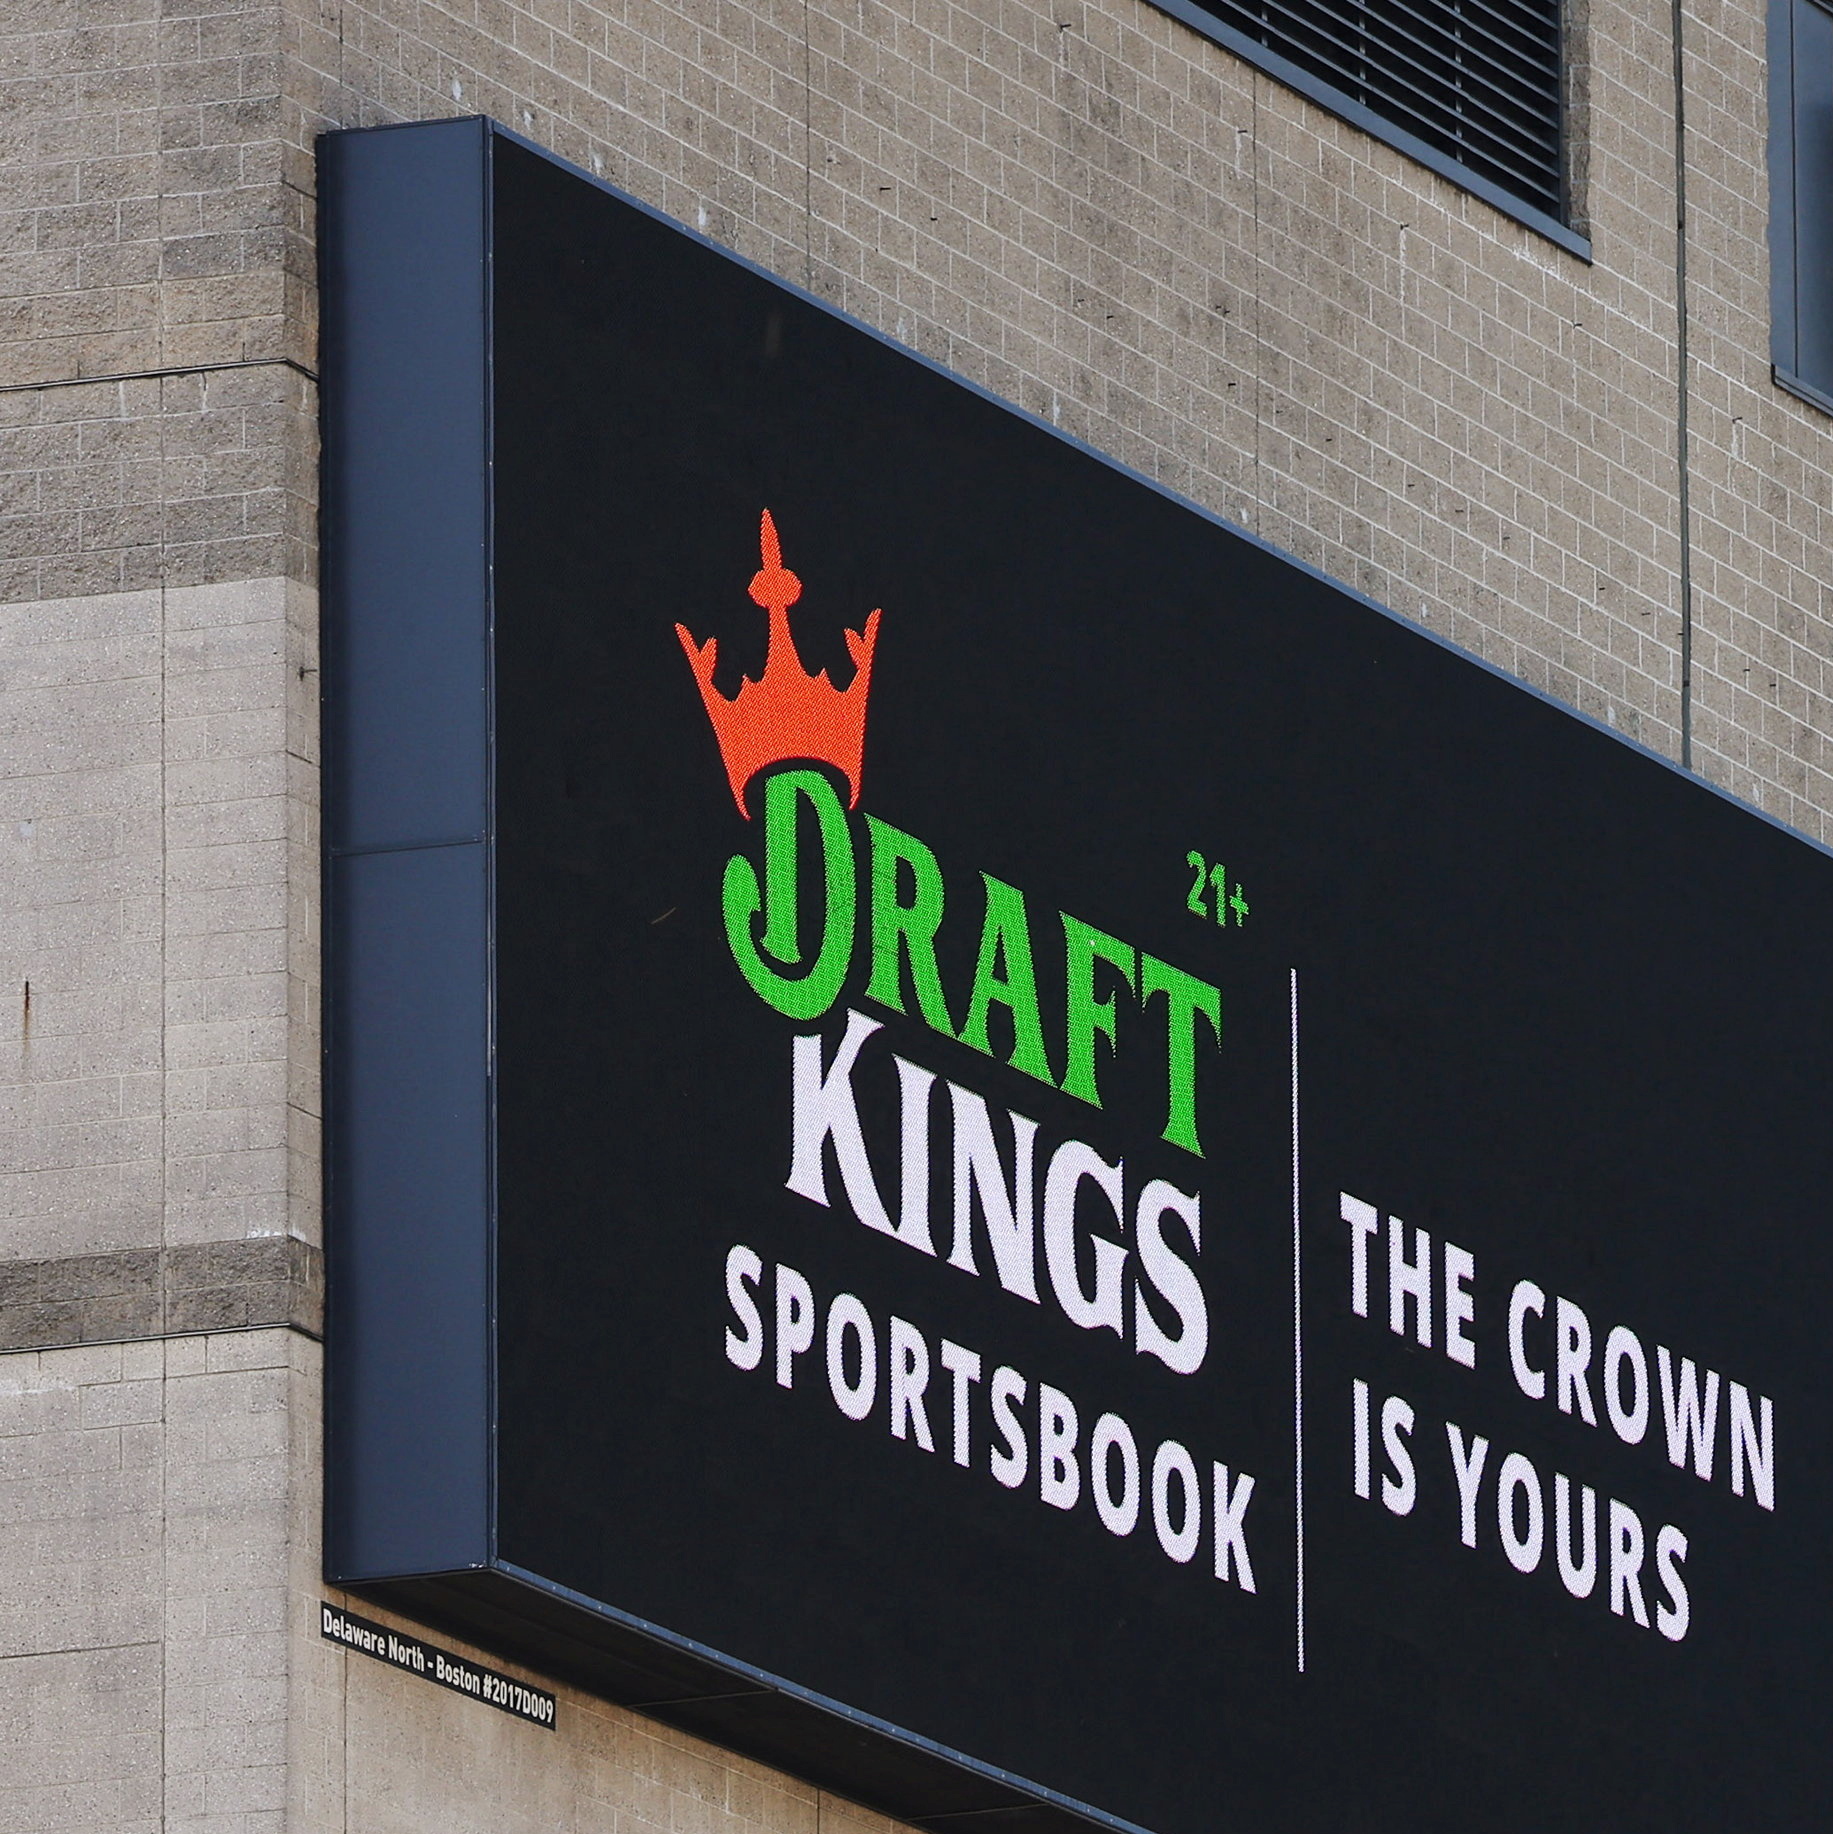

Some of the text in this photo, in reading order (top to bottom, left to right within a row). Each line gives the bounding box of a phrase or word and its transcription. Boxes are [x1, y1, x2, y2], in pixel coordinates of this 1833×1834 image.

[722, 770, 1222, 1159] DRAFT
[1186, 850, 1251, 928] 21+
[785, 1007, 1209, 1375] KINGS
[1340, 1191, 1776, 1512] THE CROWN
[724, 1244, 1257, 1594] SPORTSBOOK
[1353, 1378, 1691, 1642] IS YOURS
[322, 1608, 385, 1656] Delaware
[388, 1634, 425, 1672] North
[436, 1654, 481, 1694] Boston
